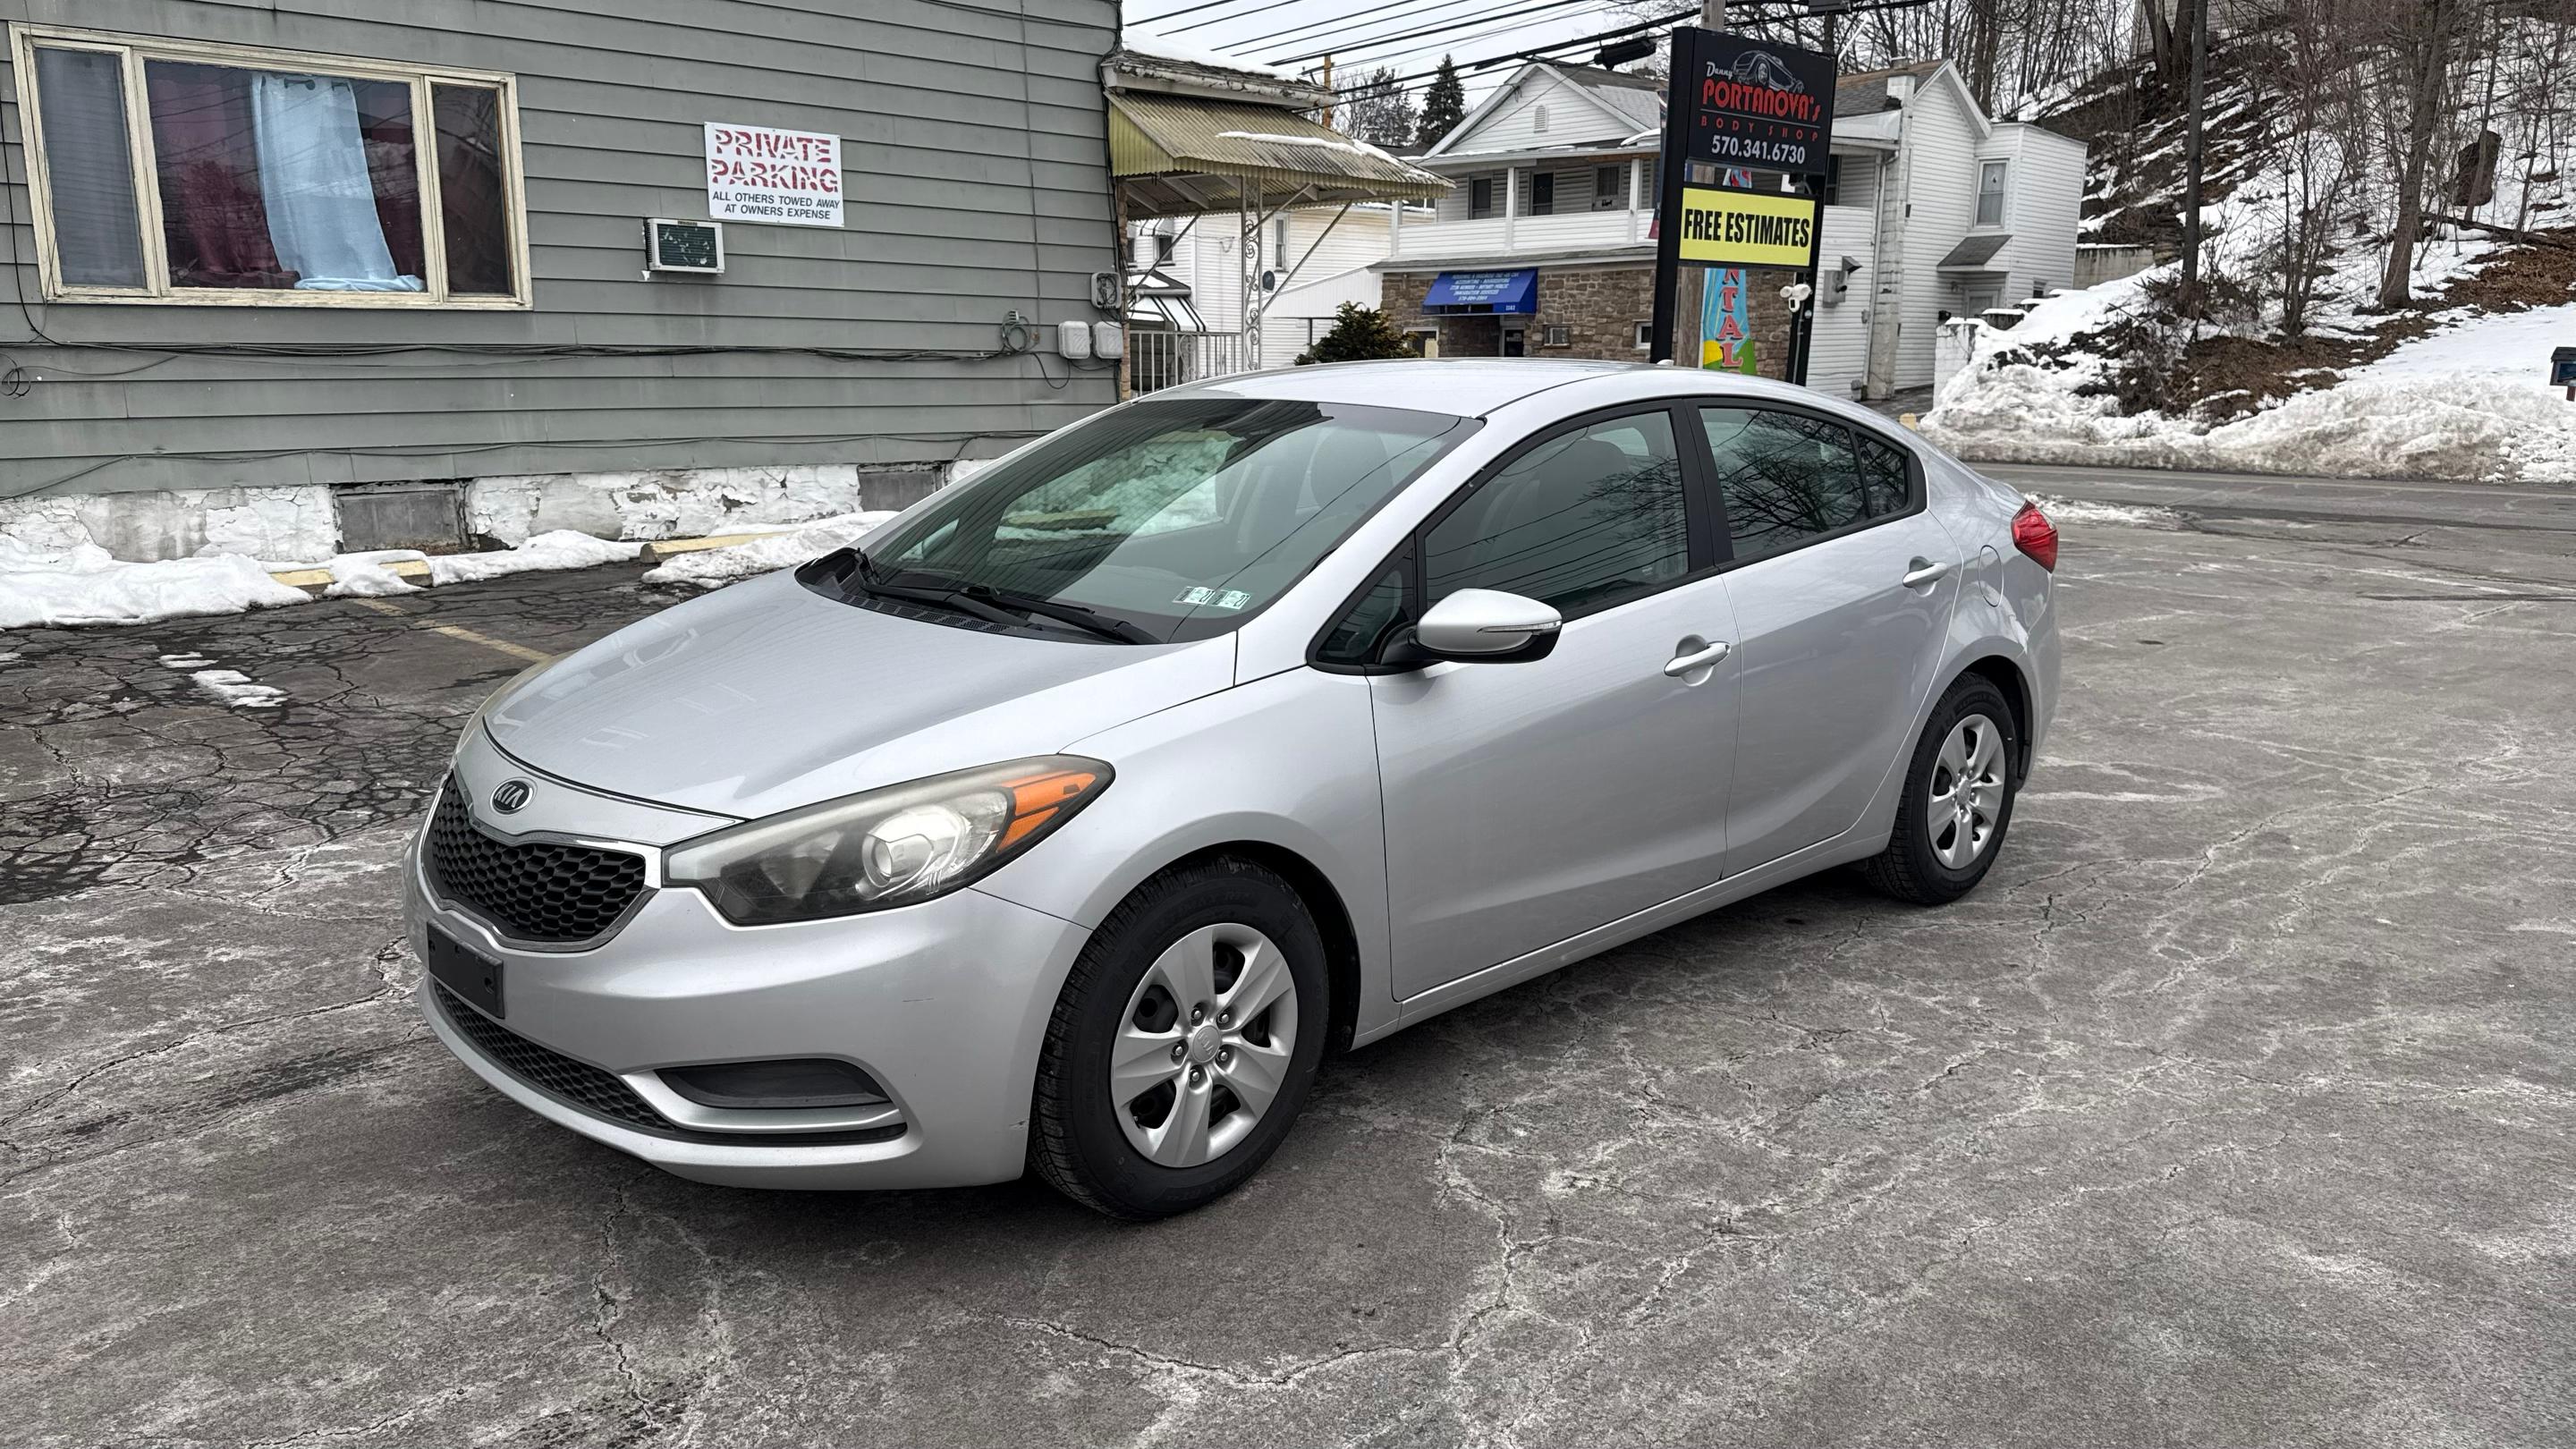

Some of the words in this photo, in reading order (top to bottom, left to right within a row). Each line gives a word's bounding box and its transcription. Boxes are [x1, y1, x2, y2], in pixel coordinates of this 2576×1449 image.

[1706, 61, 1733, 80] Danny
[1700, 115, 1755, 133] BODY
[1767, 124, 1818, 142] SHOP
[715, 129, 832, 163] PRIVATE
[1711, 135, 1806, 165] 570.341.6730
[710, 159, 838, 192] PARKING
[712, 191, 731, 201] ALL
[734, 192, 775, 204] OTHERS
[778, 195, 813, 207] TOWED
[816, 199, 840, 209] AWAY
[724, 203, 736, 213] AT
[740, 204, 784, 216] OWNERS
[787, 208, 831, 220] EXPENSE
[1683, 208, 1723, 242] FREE
[1724, 212, 1810, 249] ESTIMATES
[494, 783, 525, 809] KIA
